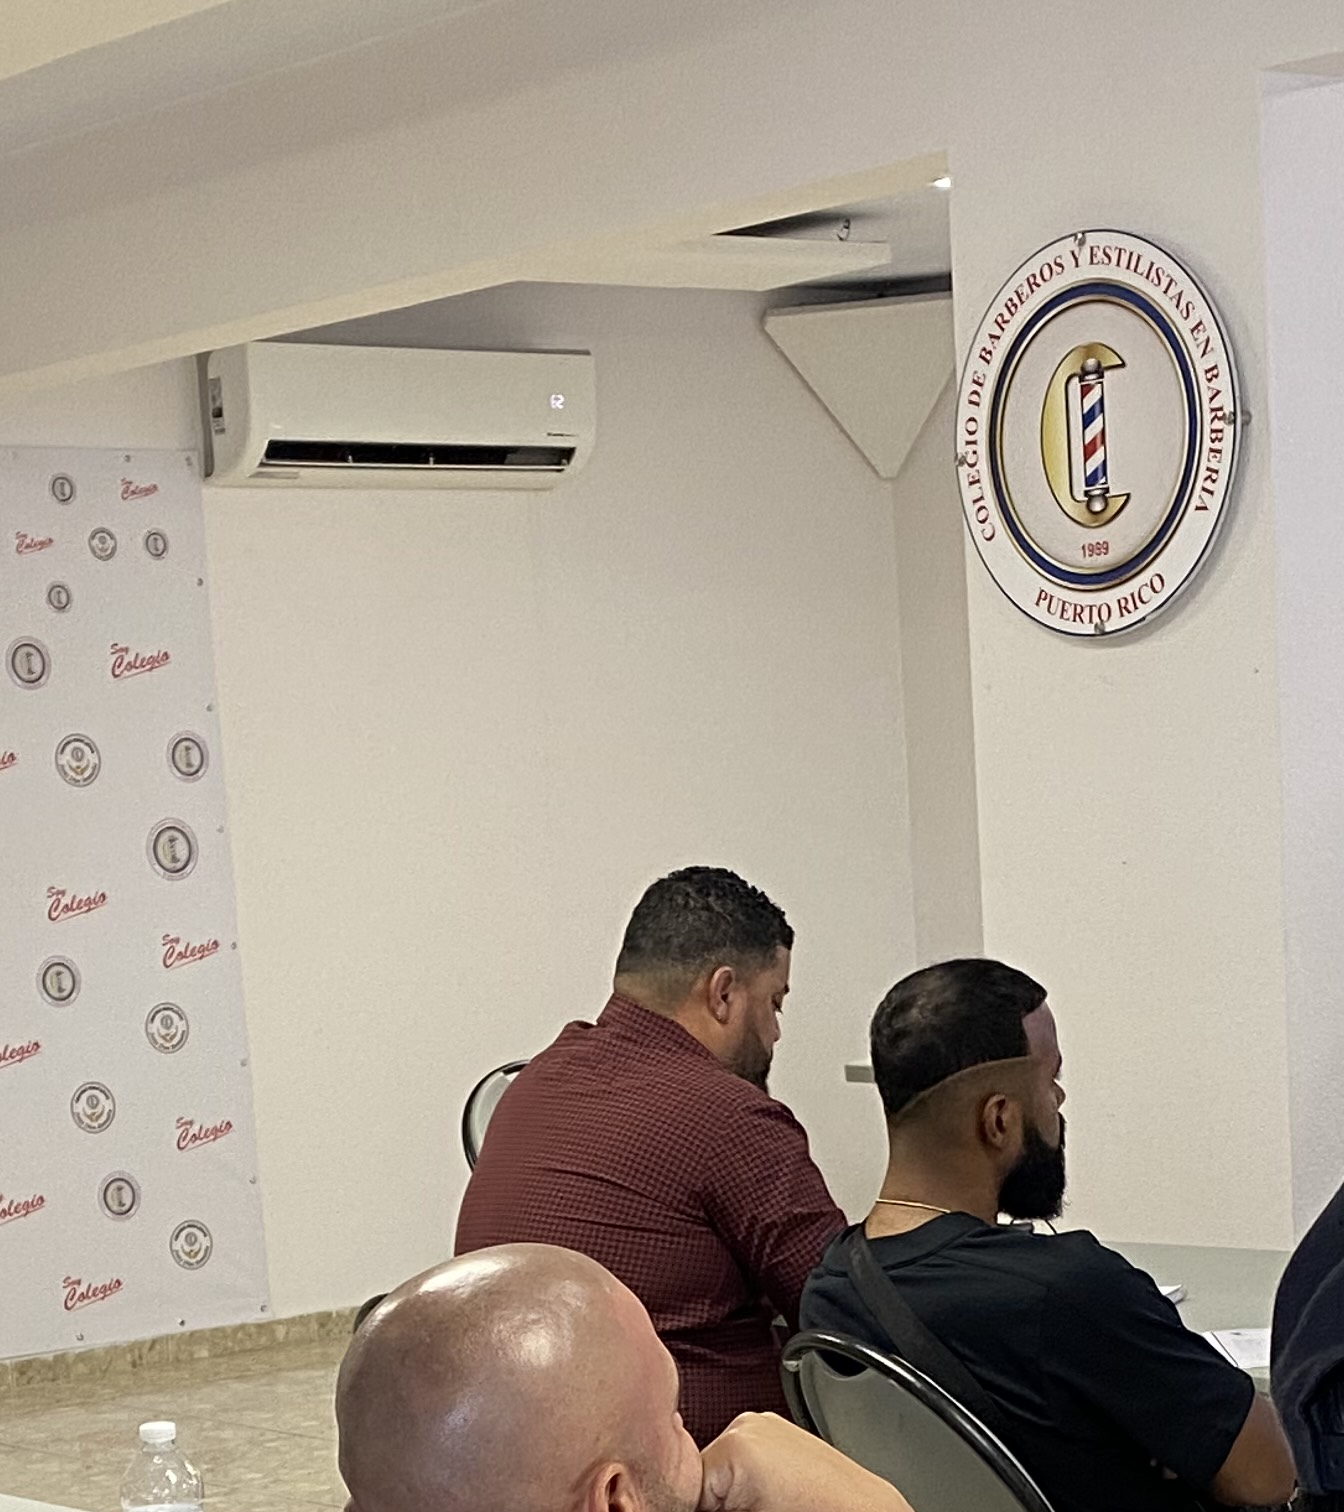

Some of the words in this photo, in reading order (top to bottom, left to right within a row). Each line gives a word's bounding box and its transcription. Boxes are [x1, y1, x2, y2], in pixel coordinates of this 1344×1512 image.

[1069, 249, 1084, 269] Y
[1089, 245, 1195, 321] ESTILISTAS
[979, 254, 1065, 366] BARBEROS
[1190, 319, 1215, 359] EN
[968, 370, 986, 408] DE
[1195, 363, 1226, 512] BARBERIA
[964, 414, 994, 542] COLEGIO
[1035, 586, 1113, 626] PUERTO
[1117, 571, 1166, 618] RICO
[112, 649, 170, 678] Colegio
[48, 891, 108, 922] Colegio
[163, 937, 220, 969] Colegio
[176, 1120, 233, 1151] Colegio
[63, 1279, 122, 1311] Colegio
